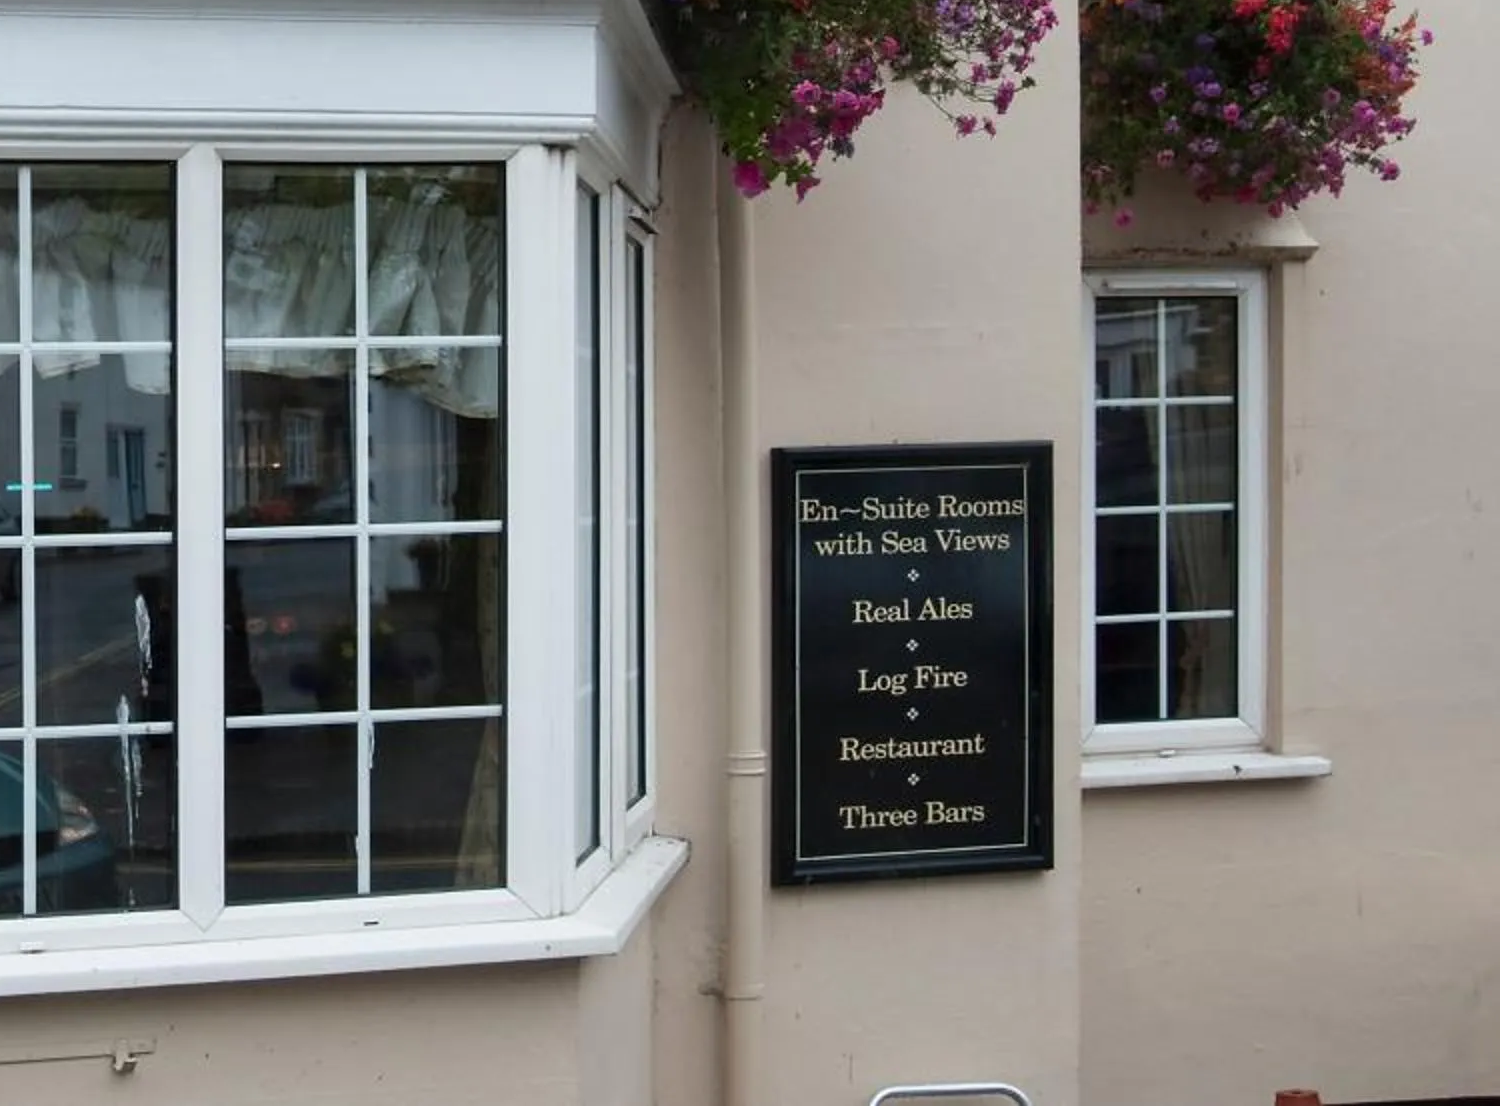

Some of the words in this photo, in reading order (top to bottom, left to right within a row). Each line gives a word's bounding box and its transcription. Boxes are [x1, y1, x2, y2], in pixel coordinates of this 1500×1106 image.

[938, 495, 1024, 517] Rooms
[815, 532, 873, 555] with
[882, 530, 927, 554] Sea
[934, 529, 1010, 551] Views
[853, 598, 910, 623] Real
[918, 597, 972, 620] Ales
[858, 670, 908, 695] Log
[914, 666, 967, 688] Fire
[840, 734, 984, 760] Restaurant
[840, 806, 917, 828] Three
[926, 802, 984, 824] Bars
